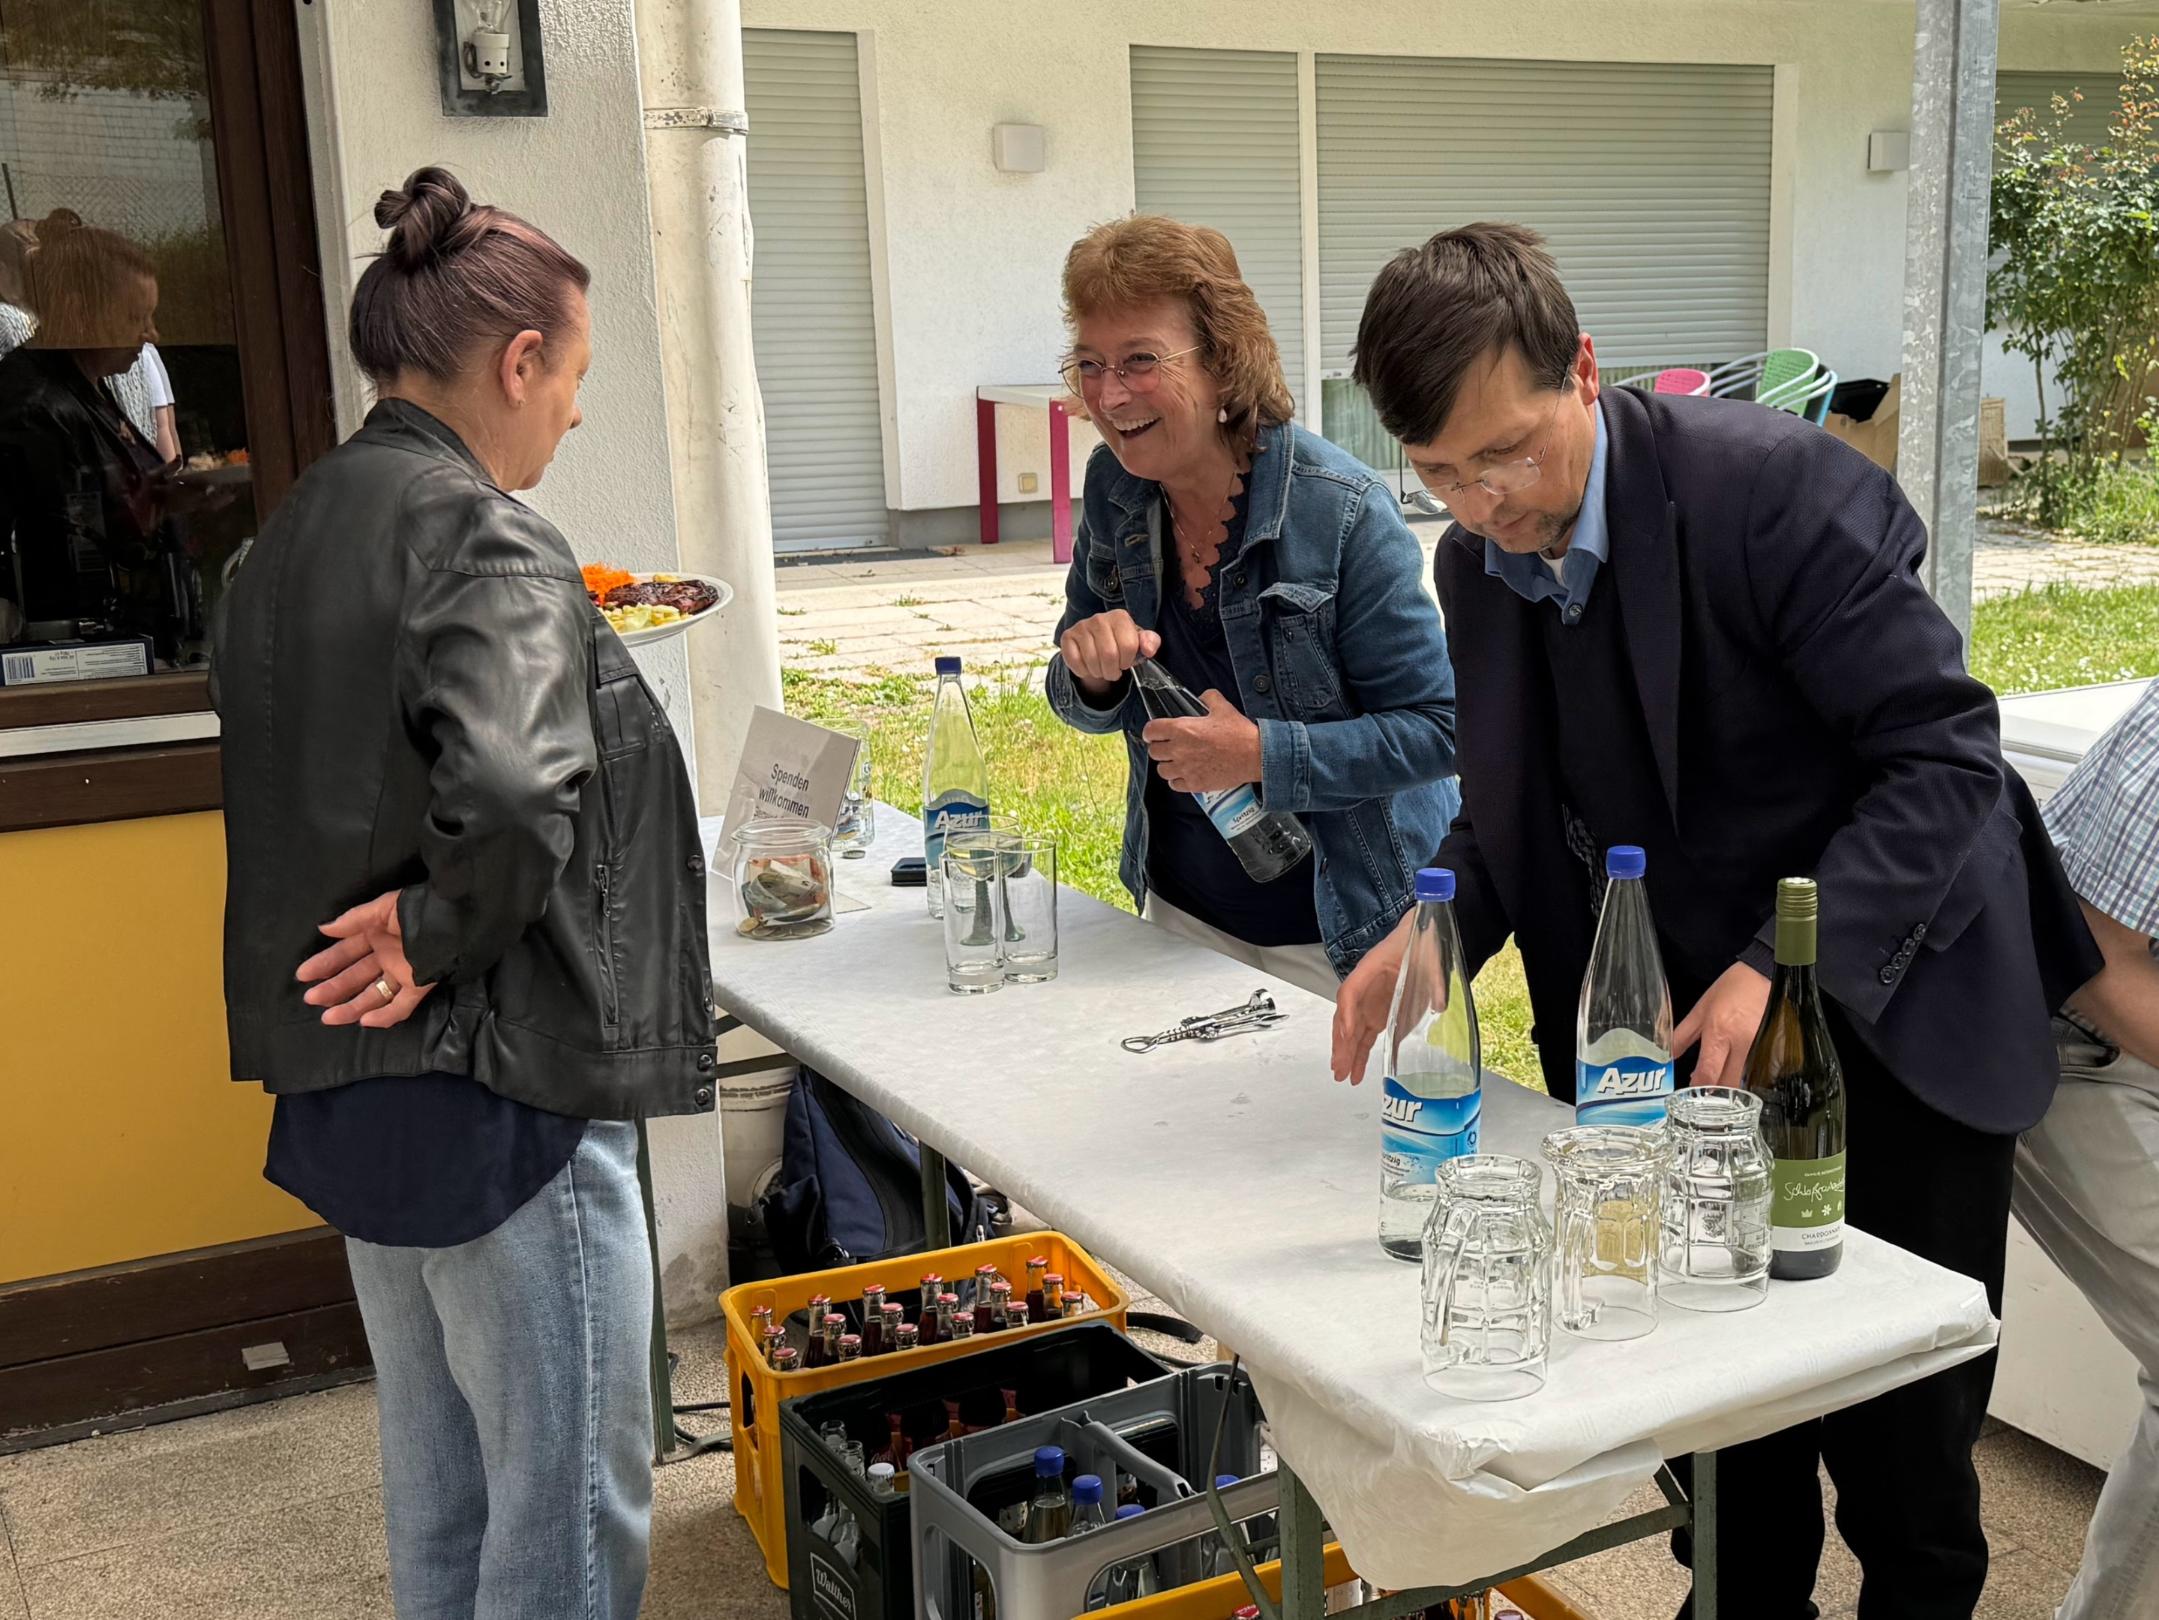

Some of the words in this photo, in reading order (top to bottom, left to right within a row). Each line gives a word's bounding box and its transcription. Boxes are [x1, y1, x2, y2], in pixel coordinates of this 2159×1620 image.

[771, 763, 809, 791] Spenden
[759, 785, 809, 818] willkommen
[934, 810, 983, 830] Azur
[1596, 1066, 1666, 1096] Azur
[1381, 1094, 1423, 1122] zur
